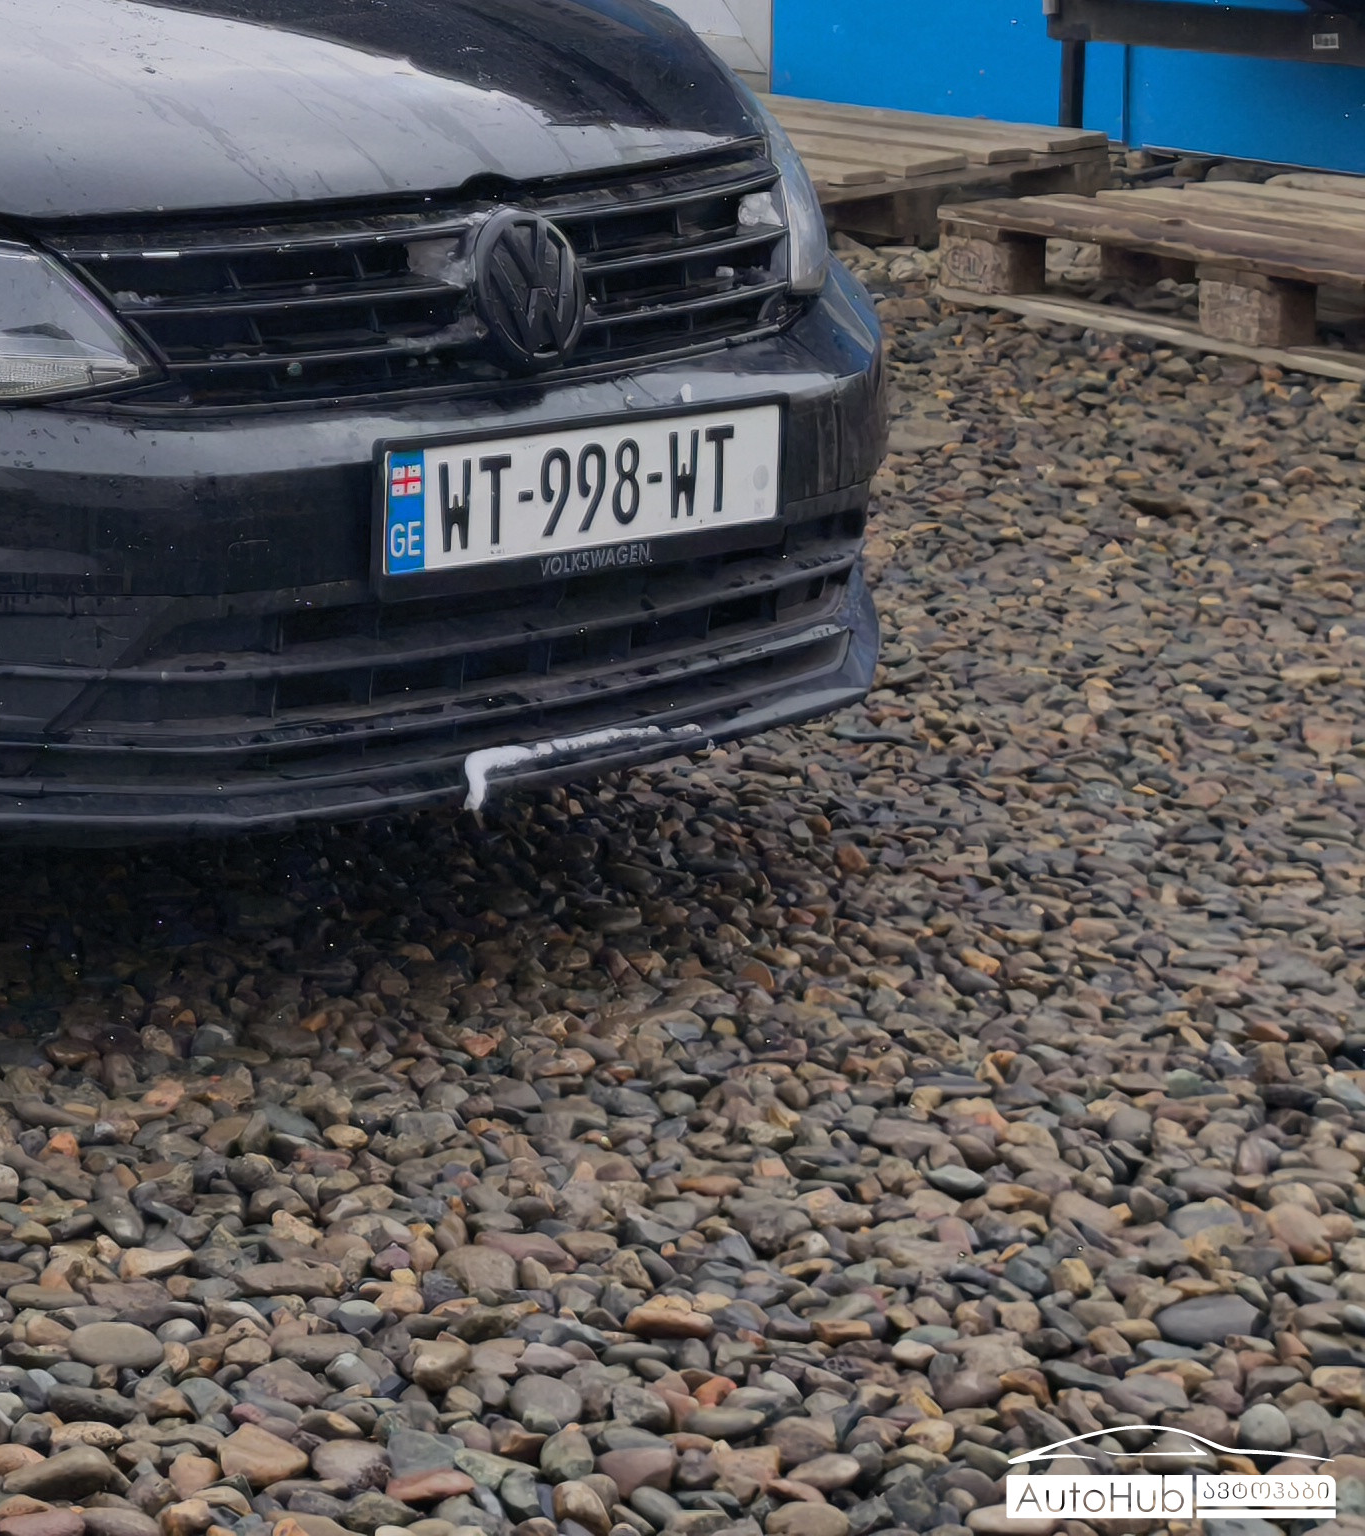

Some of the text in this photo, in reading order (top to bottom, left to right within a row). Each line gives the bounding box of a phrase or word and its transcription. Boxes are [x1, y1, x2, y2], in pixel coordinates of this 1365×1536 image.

[437, 424, 735, 553] WT-998-WT
[389, 520, 422, 559] GE
[540, 542, 652, 577] VOLKSWAGEN
